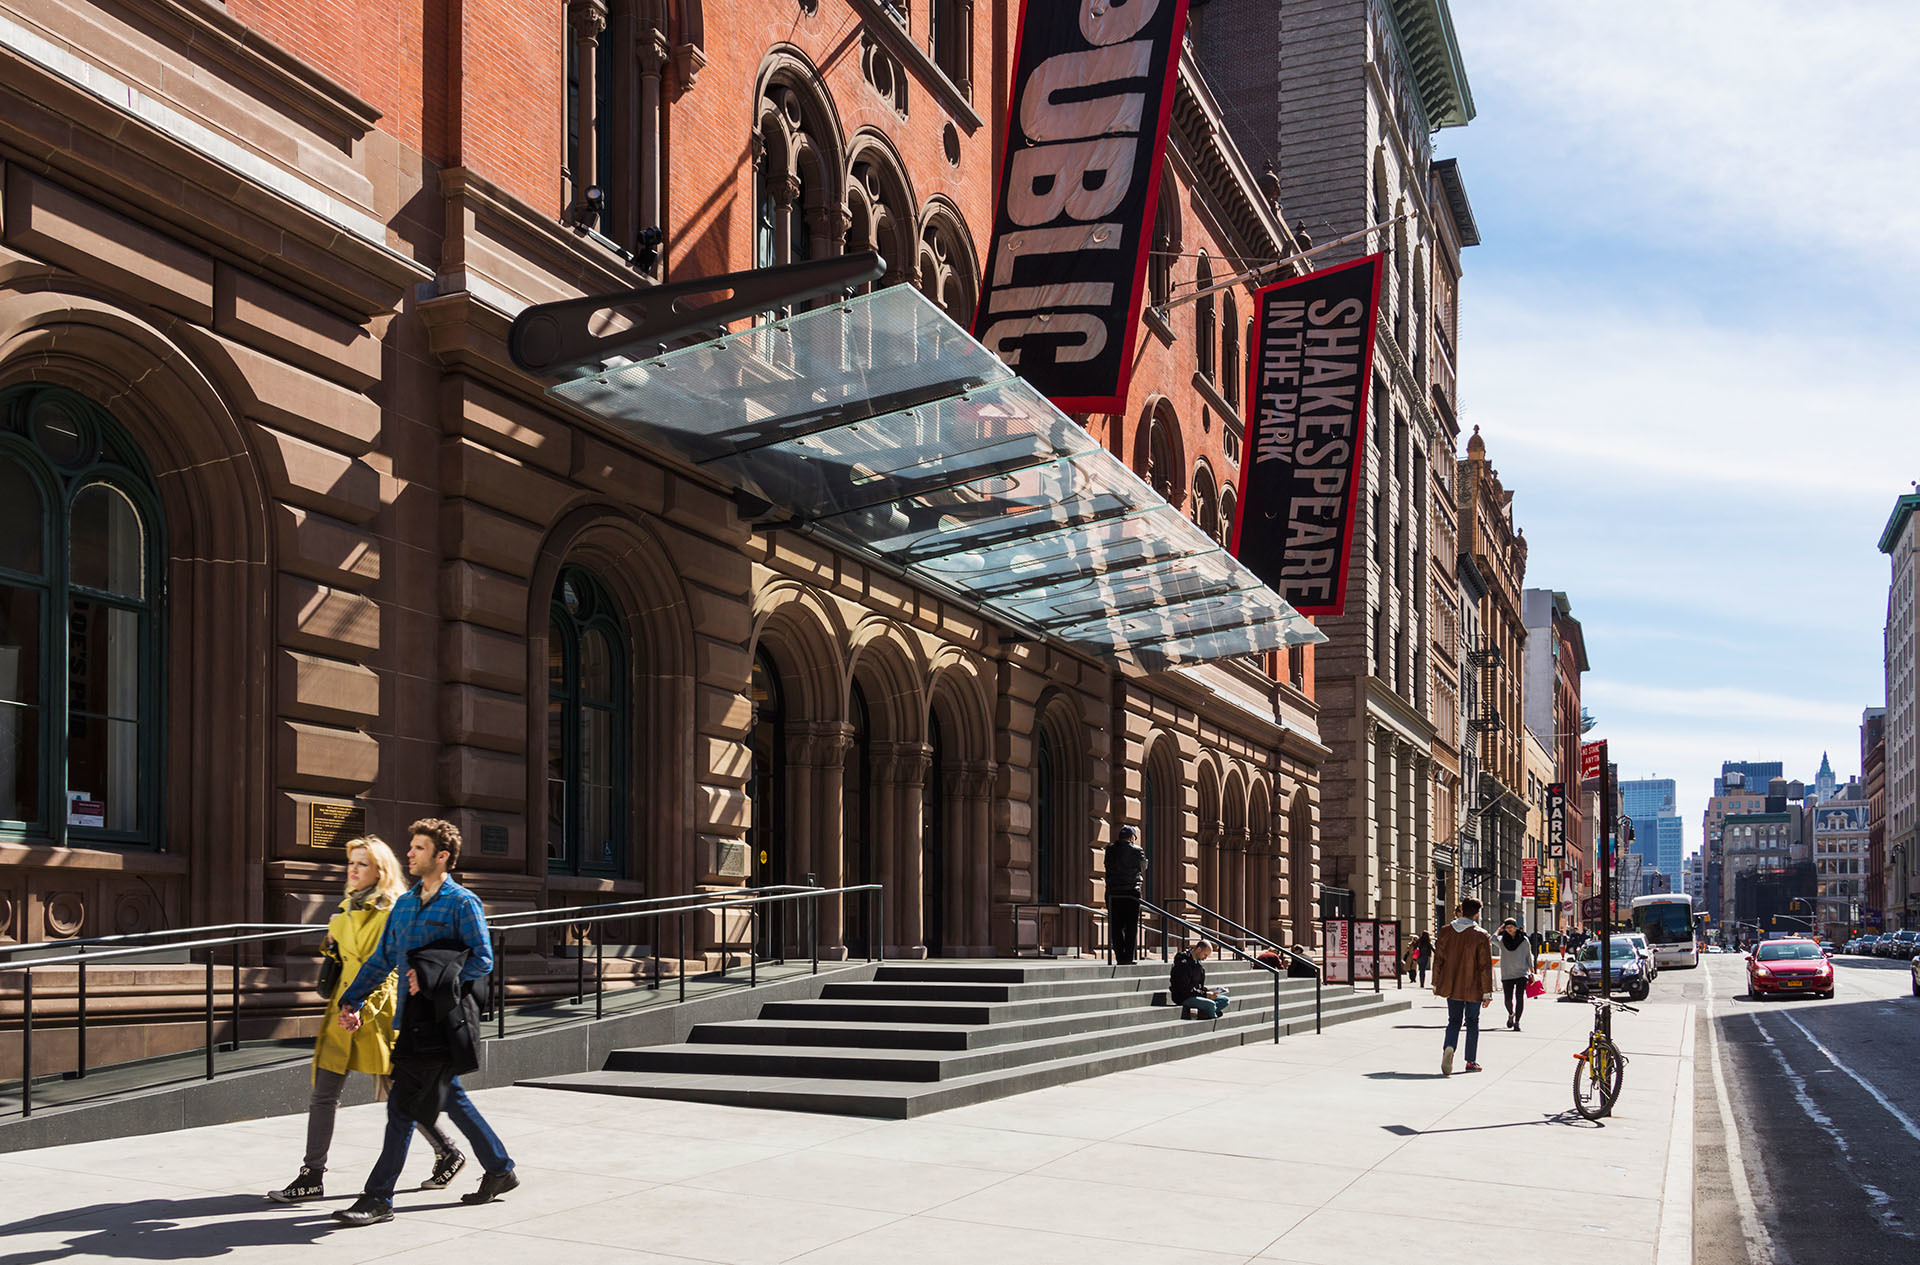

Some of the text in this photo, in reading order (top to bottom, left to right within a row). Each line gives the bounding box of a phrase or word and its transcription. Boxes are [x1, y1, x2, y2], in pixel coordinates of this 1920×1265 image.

[1256, 301, 1305, 464] IN THE PARK
[1279, 298, 1363, 600] SHAKESPEARE
[1551, 797, 1563, 843] PARK
[1339, 921, 1348, 956] LIBRARY
